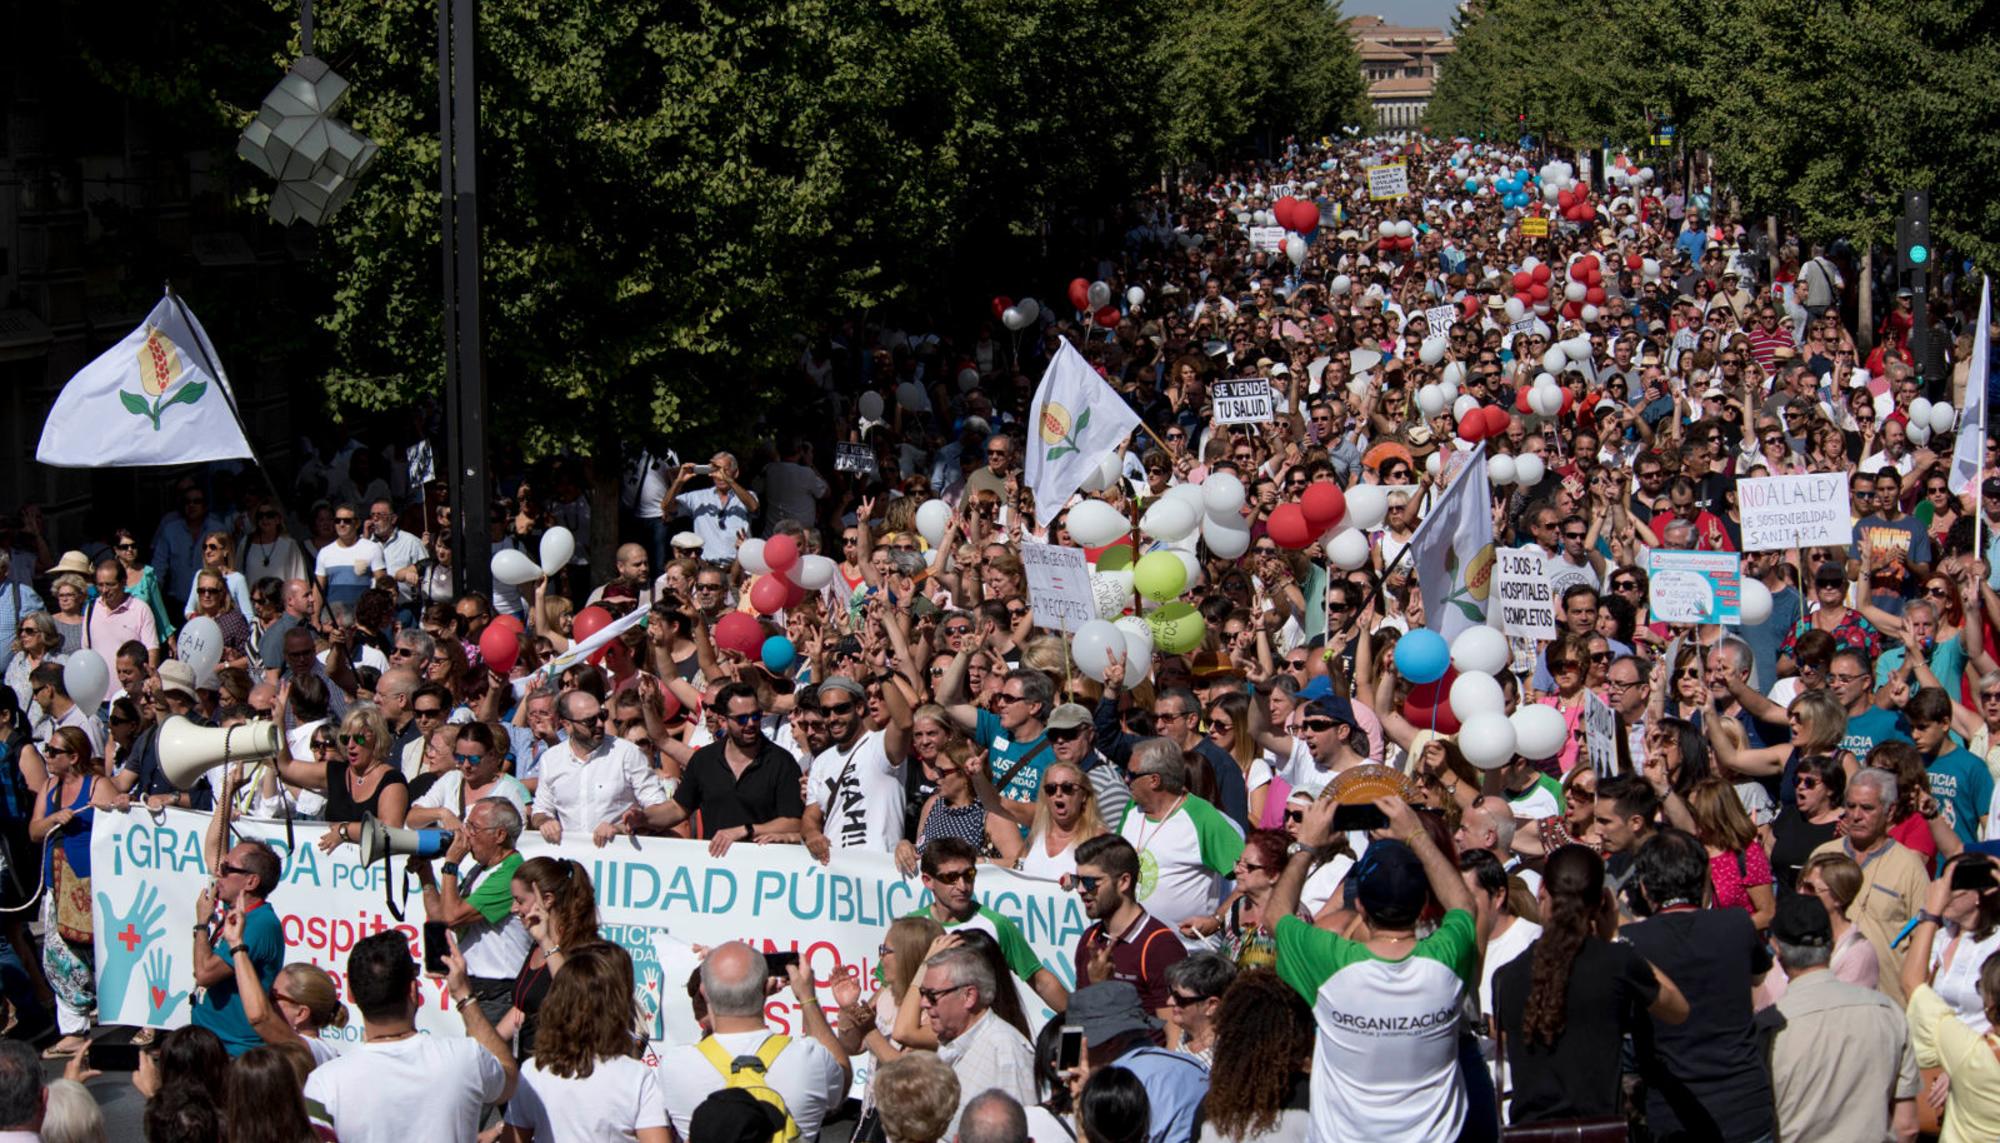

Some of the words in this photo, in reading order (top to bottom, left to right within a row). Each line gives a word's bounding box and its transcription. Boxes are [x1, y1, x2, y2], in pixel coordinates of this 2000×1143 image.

[1431, 320, 1455, 336] NO
[1214, 384, 1228, 397] SE
[1230, 382, 1267, 395] VENDE
[1218, 402, 1231, 418] TU
[1233, 400, 1268, 417] SALUD.
[1741, 484, 1764, 507] NO
[1757, 509, 1837, 527] SOSTENIBILIDAD
[1750, 526, 1829, 545] SANITARIA
[1501, 581, 1550, 602] HOSPITALES
[1504, 606, 1553, 628] COMPLETOS
[1838, 736, 1873, 748] TICIA
[1928, 772, 1957, 788] TICIA
[1331, 1007, 1457, 1031] ORGANIZACIÓN
